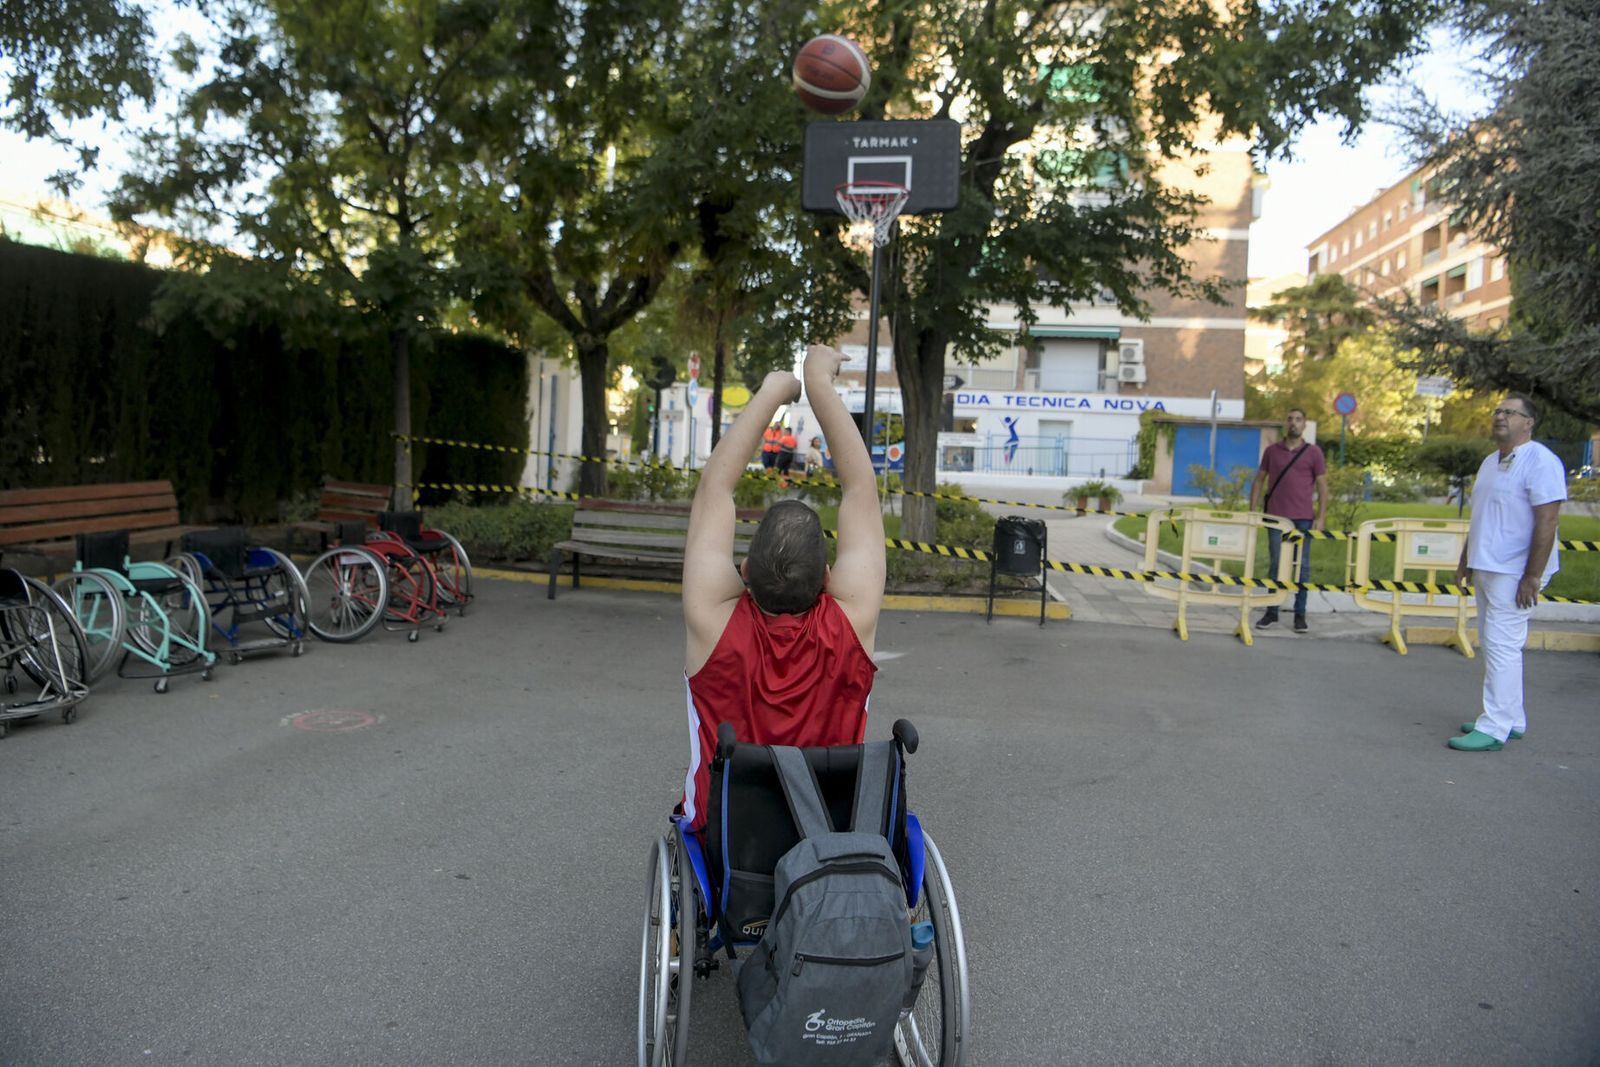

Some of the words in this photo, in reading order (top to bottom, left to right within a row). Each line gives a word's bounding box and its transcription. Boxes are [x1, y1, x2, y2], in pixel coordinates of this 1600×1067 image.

[853, 137, 909, 148] TARMAK
[1003, 395, 1091, 409] TECNICA
[1104, 399, 1168, 413] NOVA
[826, 1017, 866, 1027] Ortopedia
[825, 1024, 845, 1032] Gran
